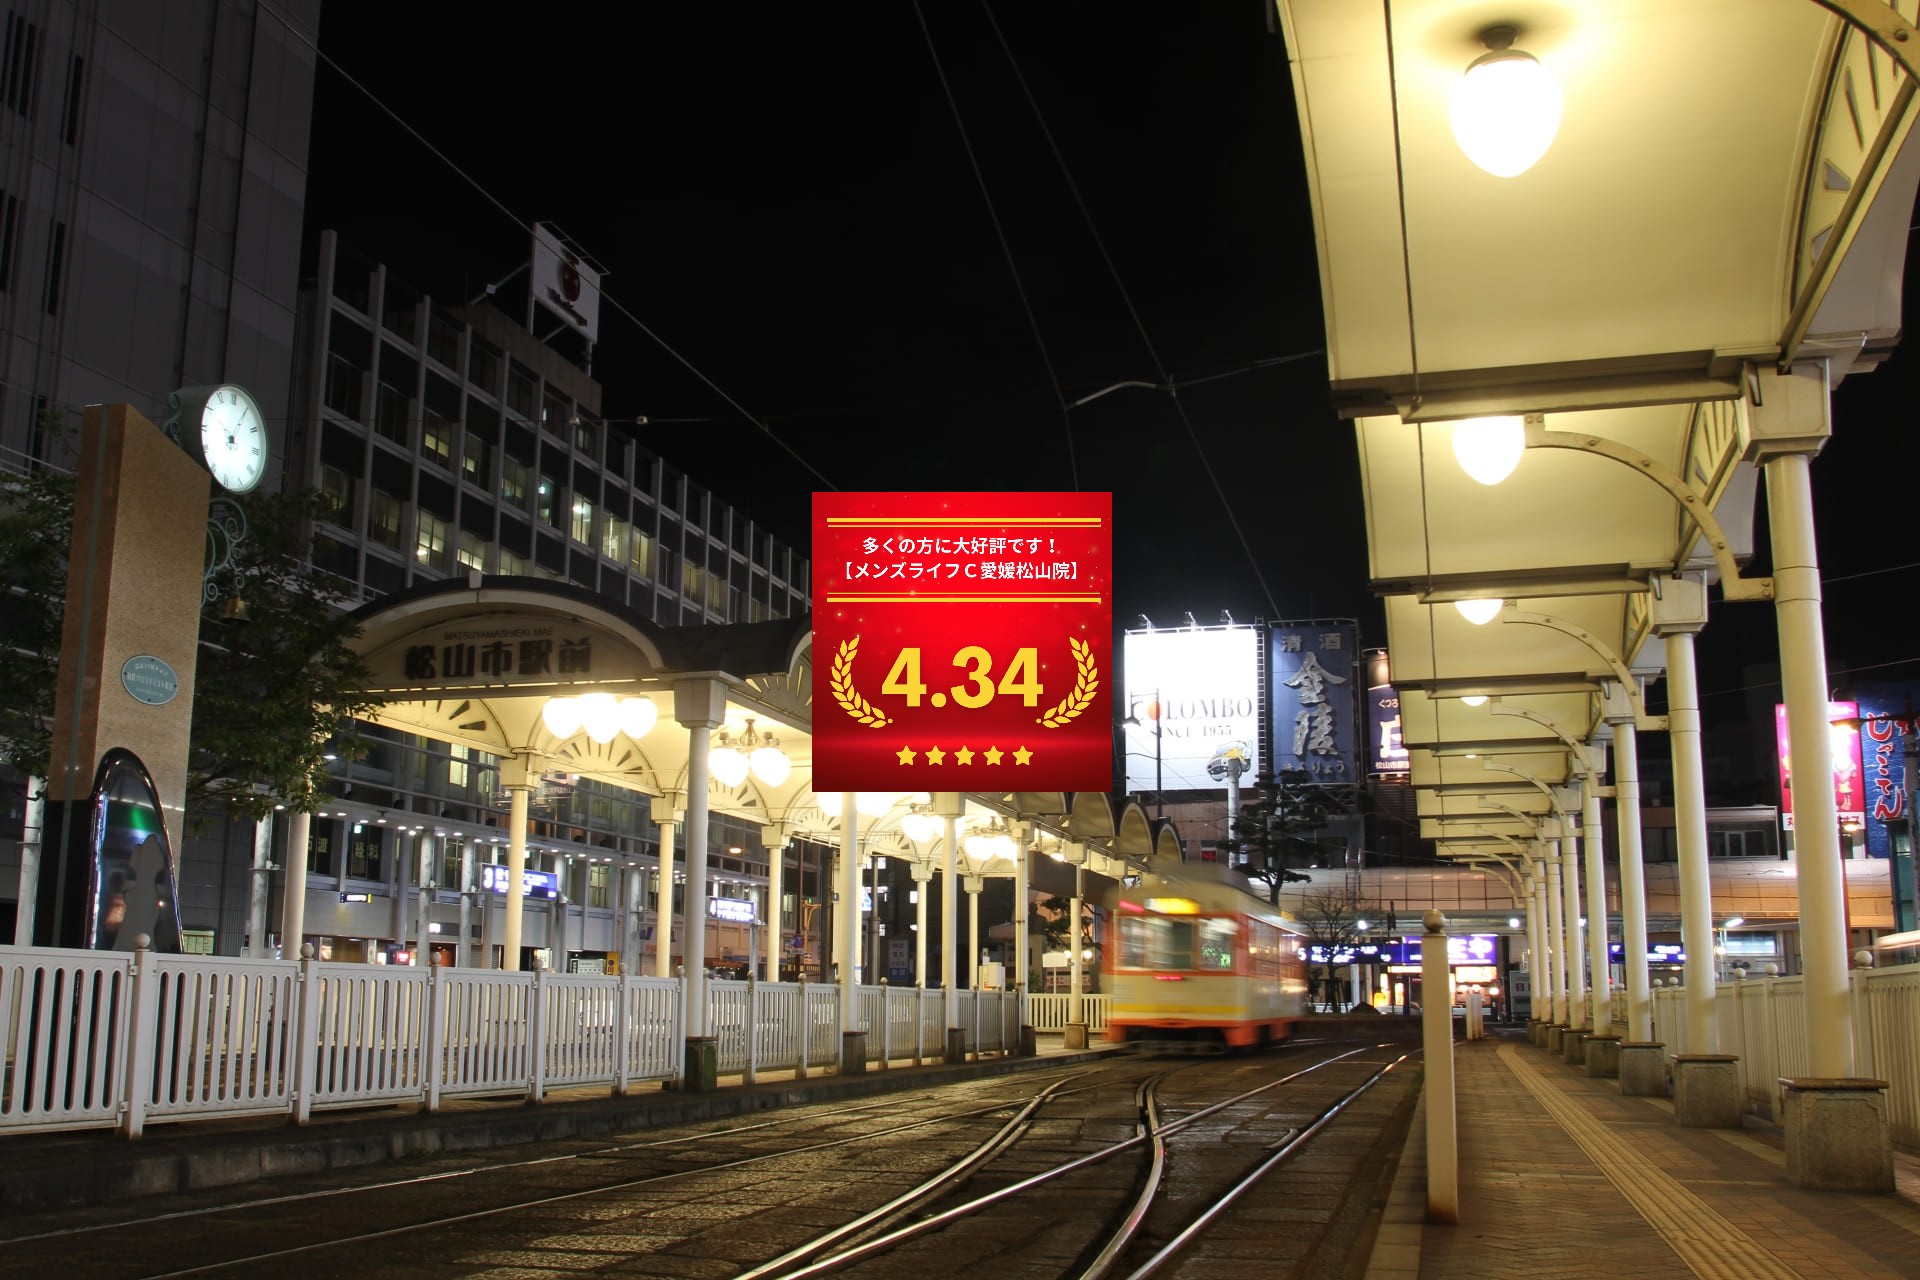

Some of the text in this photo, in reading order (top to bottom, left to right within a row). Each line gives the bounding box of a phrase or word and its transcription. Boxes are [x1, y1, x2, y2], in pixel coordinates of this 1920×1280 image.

[444, 628, 530, 641] MATSUYAMASHIEKI
[1280, 632, 1341, 652] 清酒
[405, 636, 592, 680] 松山市駅前
[1130, 698, 1253, 721] COLOMBO
